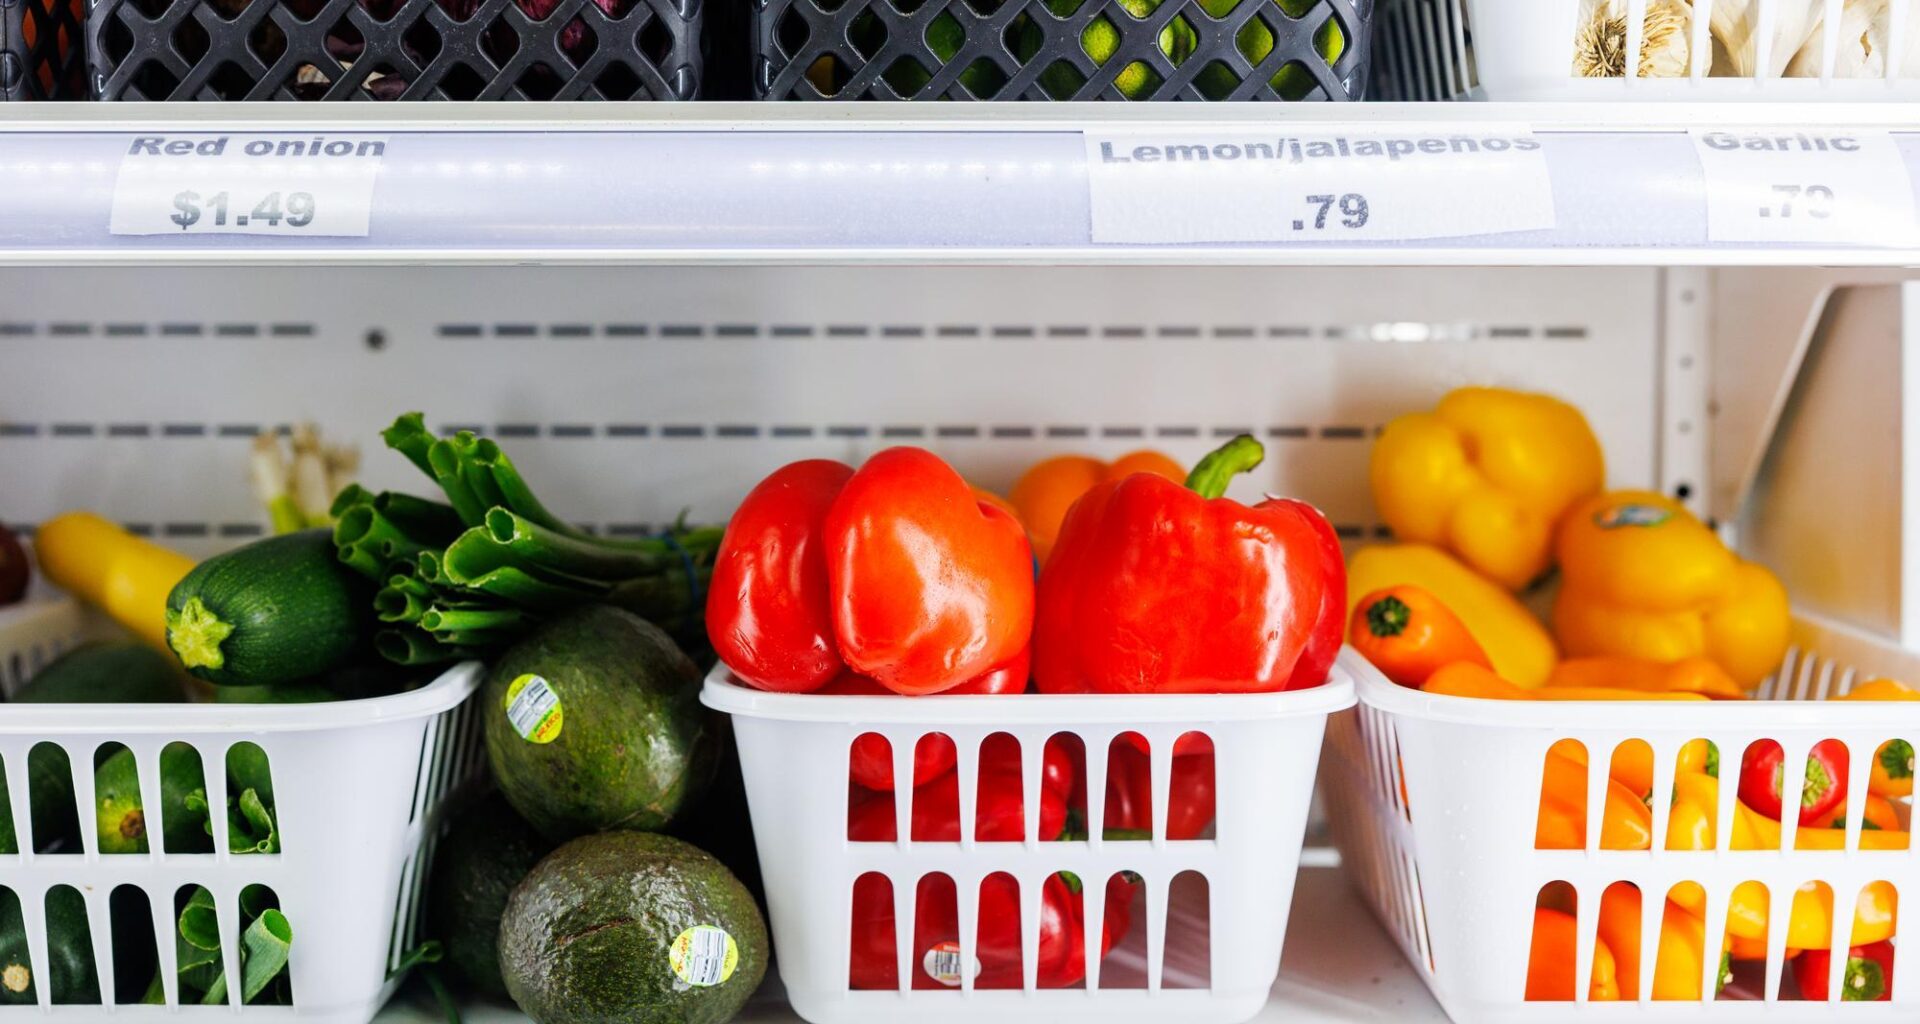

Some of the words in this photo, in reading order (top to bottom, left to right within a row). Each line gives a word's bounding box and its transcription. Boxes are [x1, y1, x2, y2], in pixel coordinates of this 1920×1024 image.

[128, 136, 229, 156] Red
[244, 136, 386, 157] onion
[1703, 132, 1861, 152] Garlic
[170, 190, 315, 230] $1.49
[1292, 193, 1369, 229] .79
